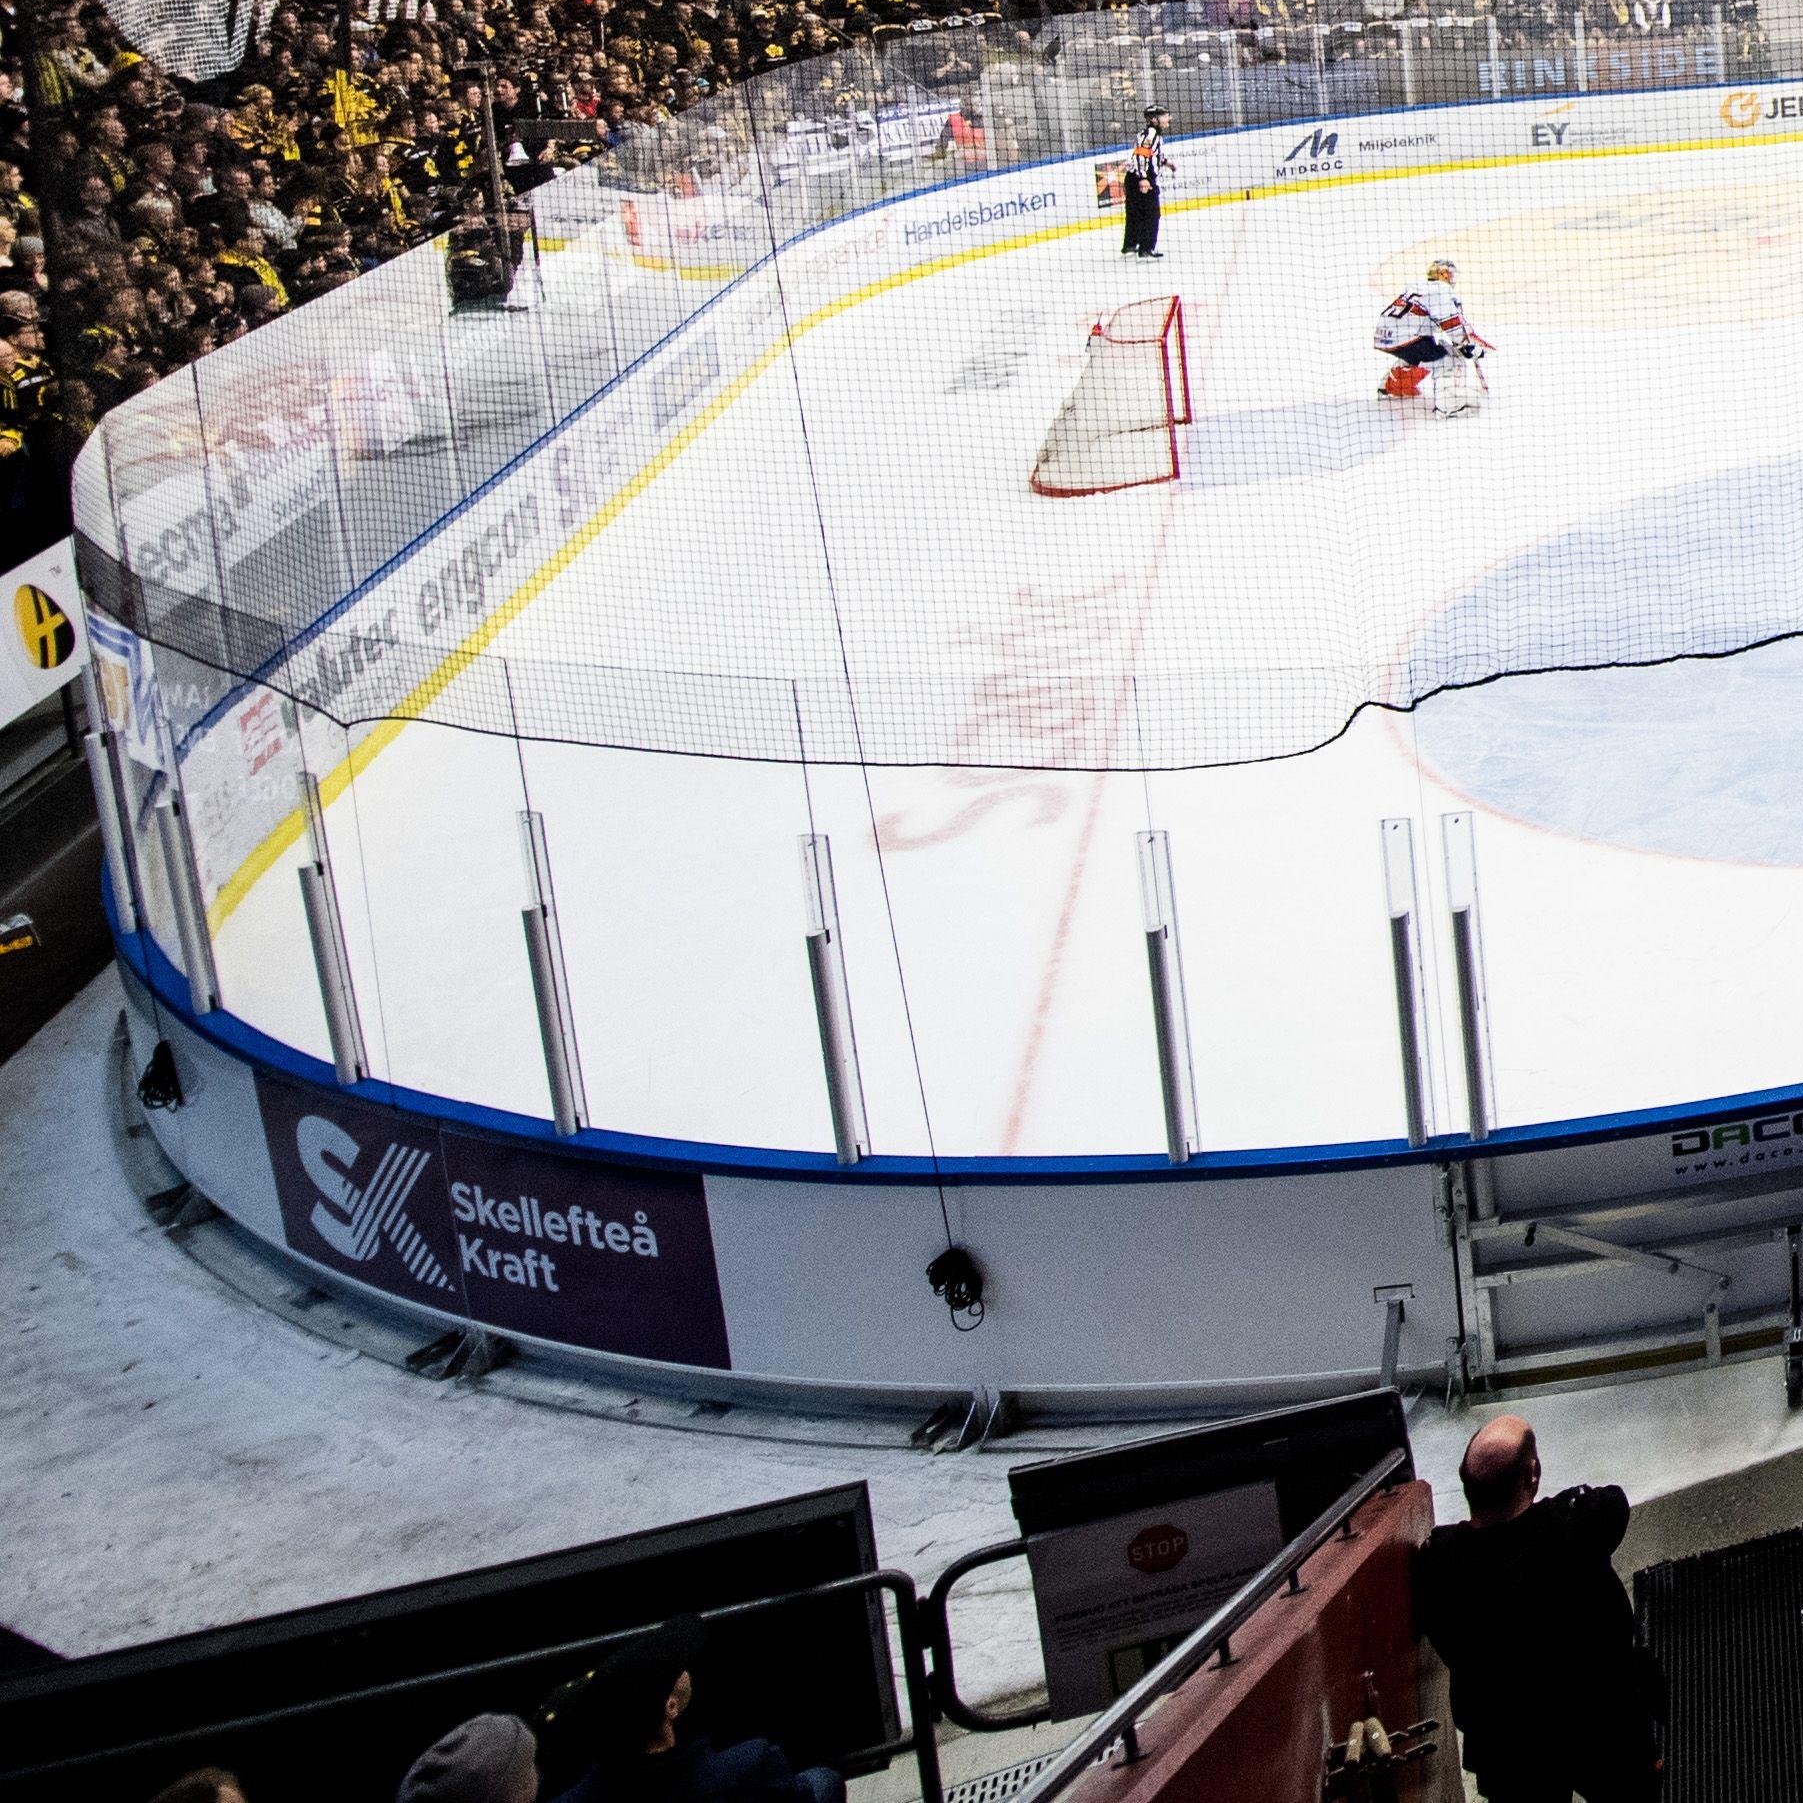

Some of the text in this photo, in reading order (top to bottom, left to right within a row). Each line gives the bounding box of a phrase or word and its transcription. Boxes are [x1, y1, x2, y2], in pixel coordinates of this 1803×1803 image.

[1359, 133, 1437, 153] Miljöteknik
[1531, 123, 1571, 147] EY
[1276, 160, 1343, 178] MIDROC
[904, 189, 1057, 246] Handelsbanken
[417, 494, 541, 638] engcon
[450, 1180, 659, 1258] Skellefteå
[459, 1233, 559, 1294] Kraft
[1131, 1534, 1185, 1563] STOP
